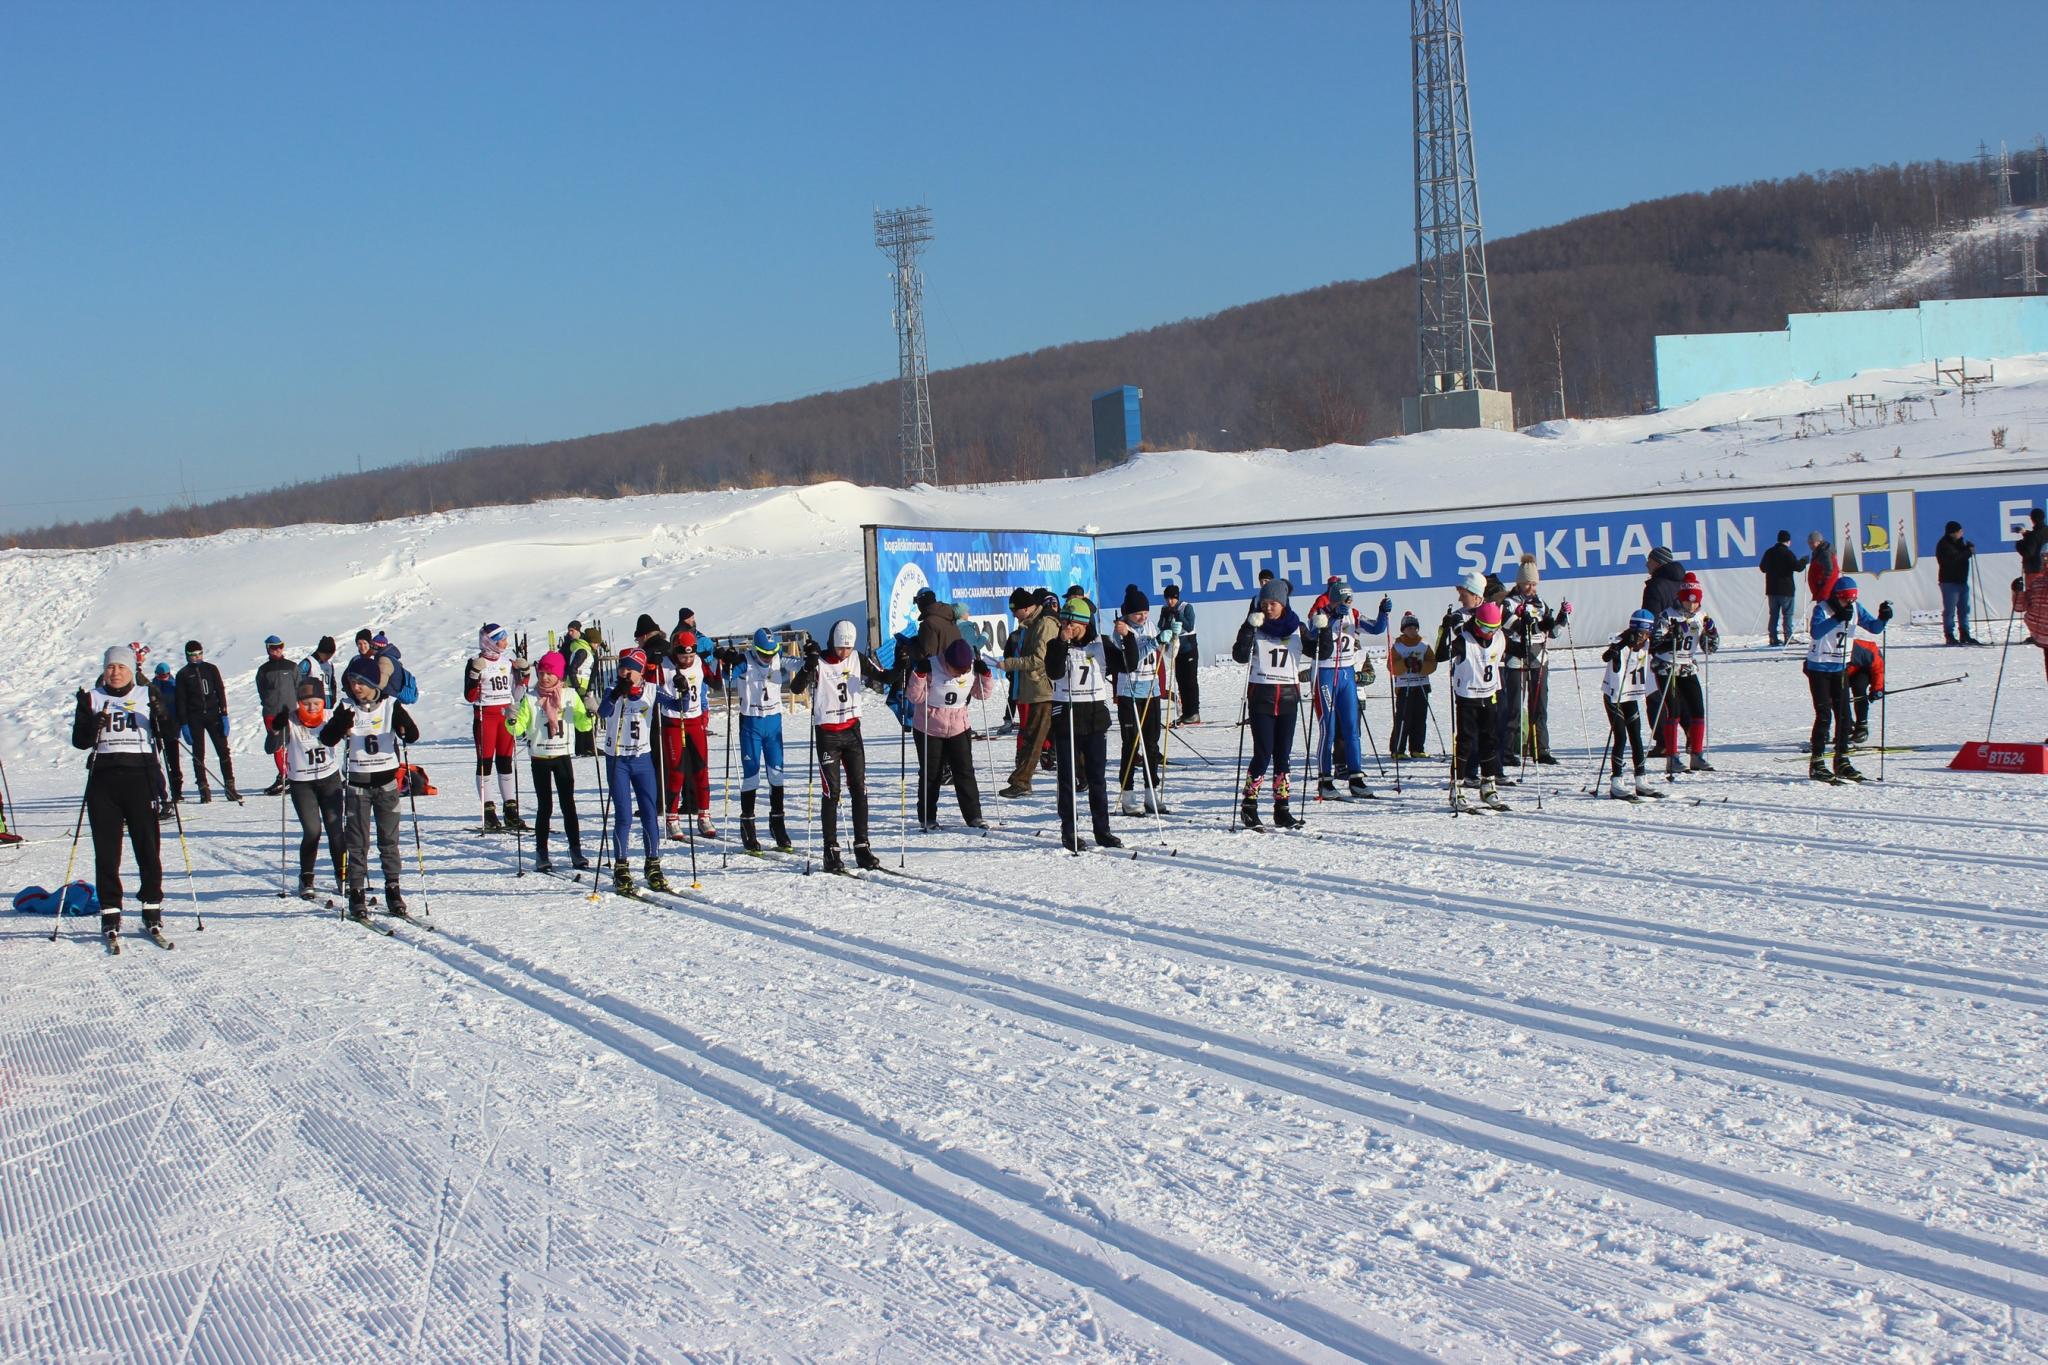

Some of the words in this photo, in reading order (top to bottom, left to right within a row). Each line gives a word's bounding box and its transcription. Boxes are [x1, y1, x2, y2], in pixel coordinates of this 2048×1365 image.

[2000, 498, 2048, 541] Б
[936, 552, 965, 573] КУБОК
[967, 552, 992, 573] АННЫ
[994, 548, 1030, 572] БОГАЛИЙ
[1152, 539, 1432, 596] BIATHLON
[1455, 516, 1757, 576] SAKHALIN
[1836, 632, 1846, 648] 2
[1269, 648, 1289, 668] 17
[1079, 665, 1089, 685] 7
[1483, 665, 1493, 682] 8
[1630, 667, 1646, 685] 11
[489, 676, 509, 691] 169
[837, 682, 848, 703] 3
[945, 692, 957, 706] 9
[105, 711, 138, 733] 154
[630, 721, 641, 740] 5
[364, 734, 379, 755] 6
[305, 747, 327, 765] 15
[1987, 751, 2025, 765] ВТБ24
